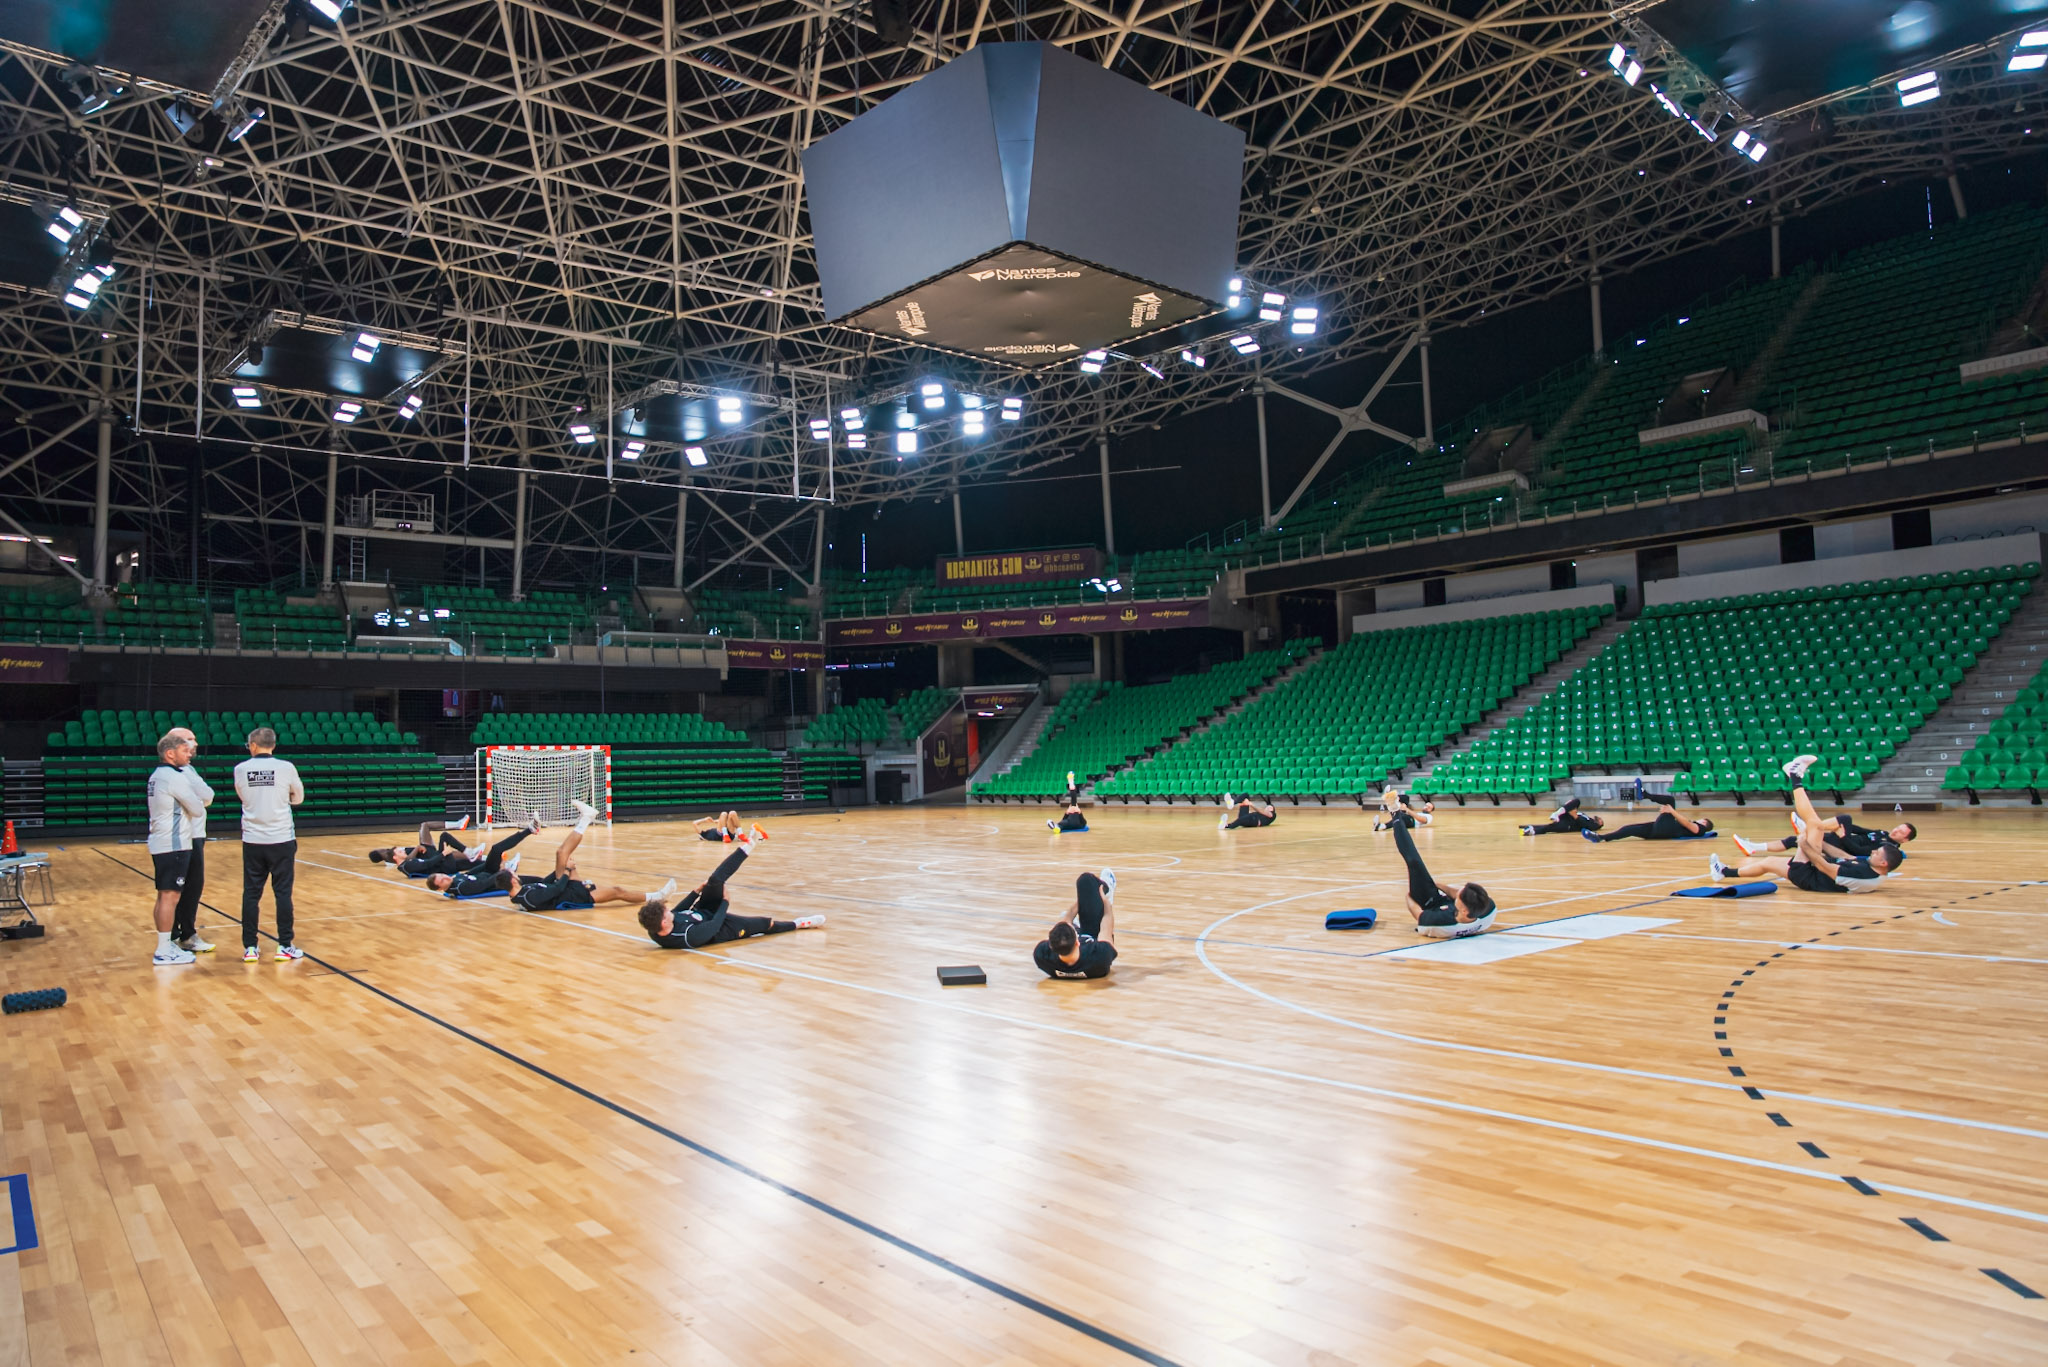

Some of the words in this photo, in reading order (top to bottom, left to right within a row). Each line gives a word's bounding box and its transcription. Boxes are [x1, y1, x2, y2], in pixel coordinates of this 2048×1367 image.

[996, 267, 1056, 275] Nantes
[1982, 707, 1990, 715] G
[1969, 722, 1976, 730] F
[1955, 737, 1962, 745] E
[1940, 752, 1948, 760] D
[1925, 768, 1933, 776] C
[1910, 785, 1918, 793] B
[1894, 803, 1903, 811] A
